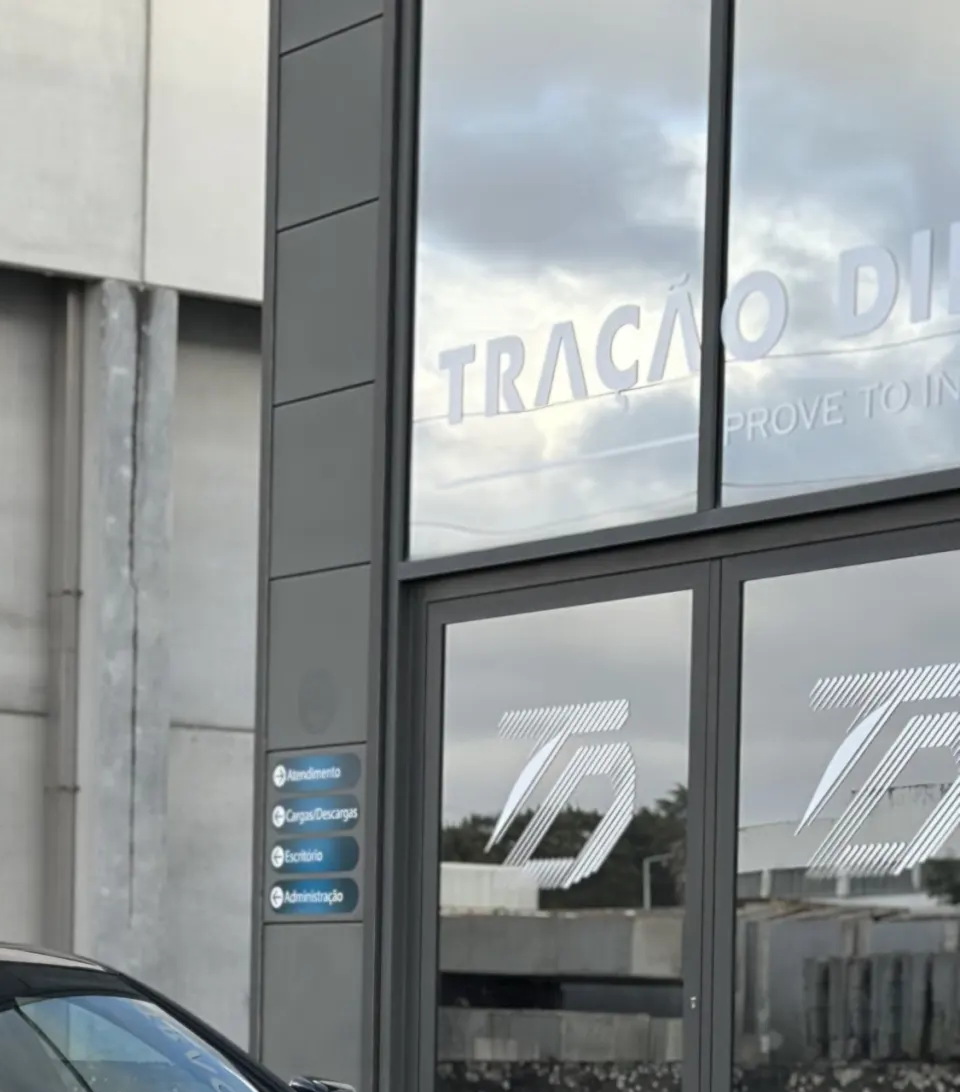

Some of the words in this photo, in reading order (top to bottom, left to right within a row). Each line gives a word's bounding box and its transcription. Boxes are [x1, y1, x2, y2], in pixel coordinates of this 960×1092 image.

[439, 272, 789, 425] TRAÇÃO
[724, 389, 845, 447] PROVE
[860, 380, 911, 417] TO
[286, 766, 341, 782] Atendimento
[286, 807, 358, 825] Cargas/Descargas
[284, 848, 323, 863] Escritório
[284, 889, 344, 906] Administração
